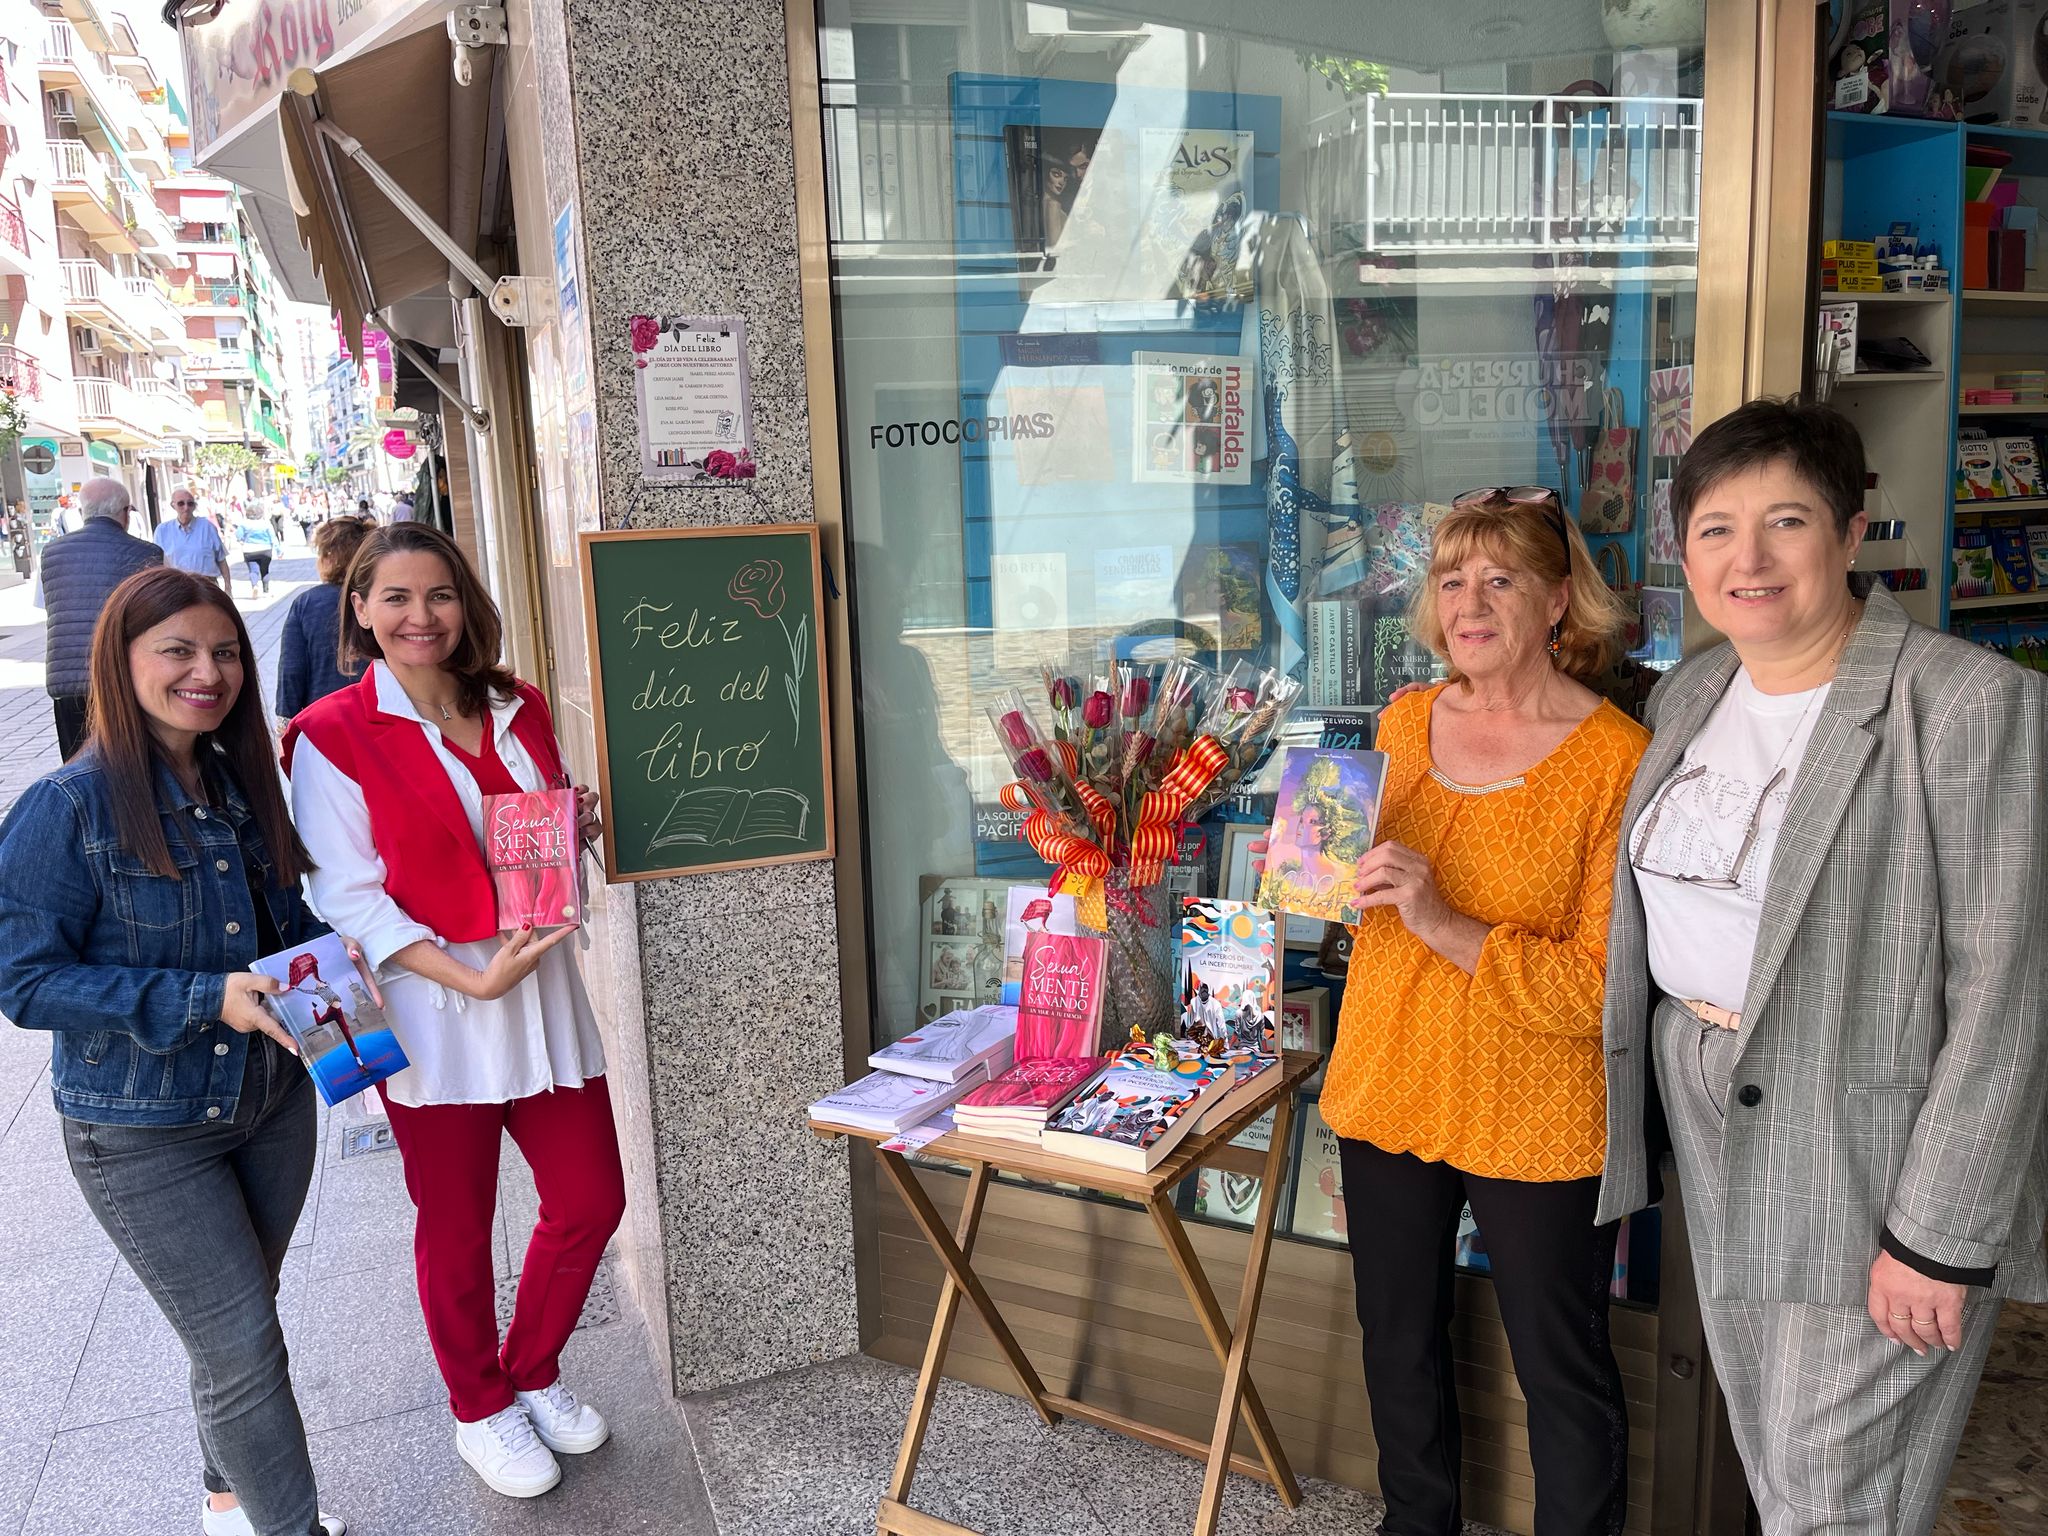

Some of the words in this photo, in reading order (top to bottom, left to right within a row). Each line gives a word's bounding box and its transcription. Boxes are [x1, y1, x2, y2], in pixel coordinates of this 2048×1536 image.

[1839, 242, 1854, 251] PLUS
[1839, 260, 1855, 269] PLUS
[1841, 277, 1859, 285] PLUS
[696, 333, 716, 343] Feliz
[1179, 365, 1208, 375] mejor
[1210, 365, 1222, 375] de
[1224, 366, 1245, 468] mafalda
[870, 412, 1056, 449] FOTOCOPIAS
[1960, 444, 1988, 452] GIOTTO
[2005, 442, 2030, 450] GIOTTO
[1103, 563, 1161, 576] SENDERISTAS
[622, 595, 744, 650] Feliz
[1392, 655, 1429, 663] NOMBRE
[1390, 666, 1431, 675] VIENTO
[632, 667, 696, 711] día
[720, 665, 769, 702] del
[1314, 716, 1364, 725] HAZELWOOD
[977, 812, 990, 821] LA
[494, 804, 564, 840] Sexual
[496, 830, 566, 850] MENTE
[494, 846, 566, 863] SANANDO
[1207, 952, 1236, 960] MISTERIOS
[1030, 945, 1091, 981] Sexual
[1208, 960, 1254, 971] INCERTIDUMBRE
[1029, 977, 1090, 998] MENTE
[1027, 993, 1088, 1011] SANANDO
